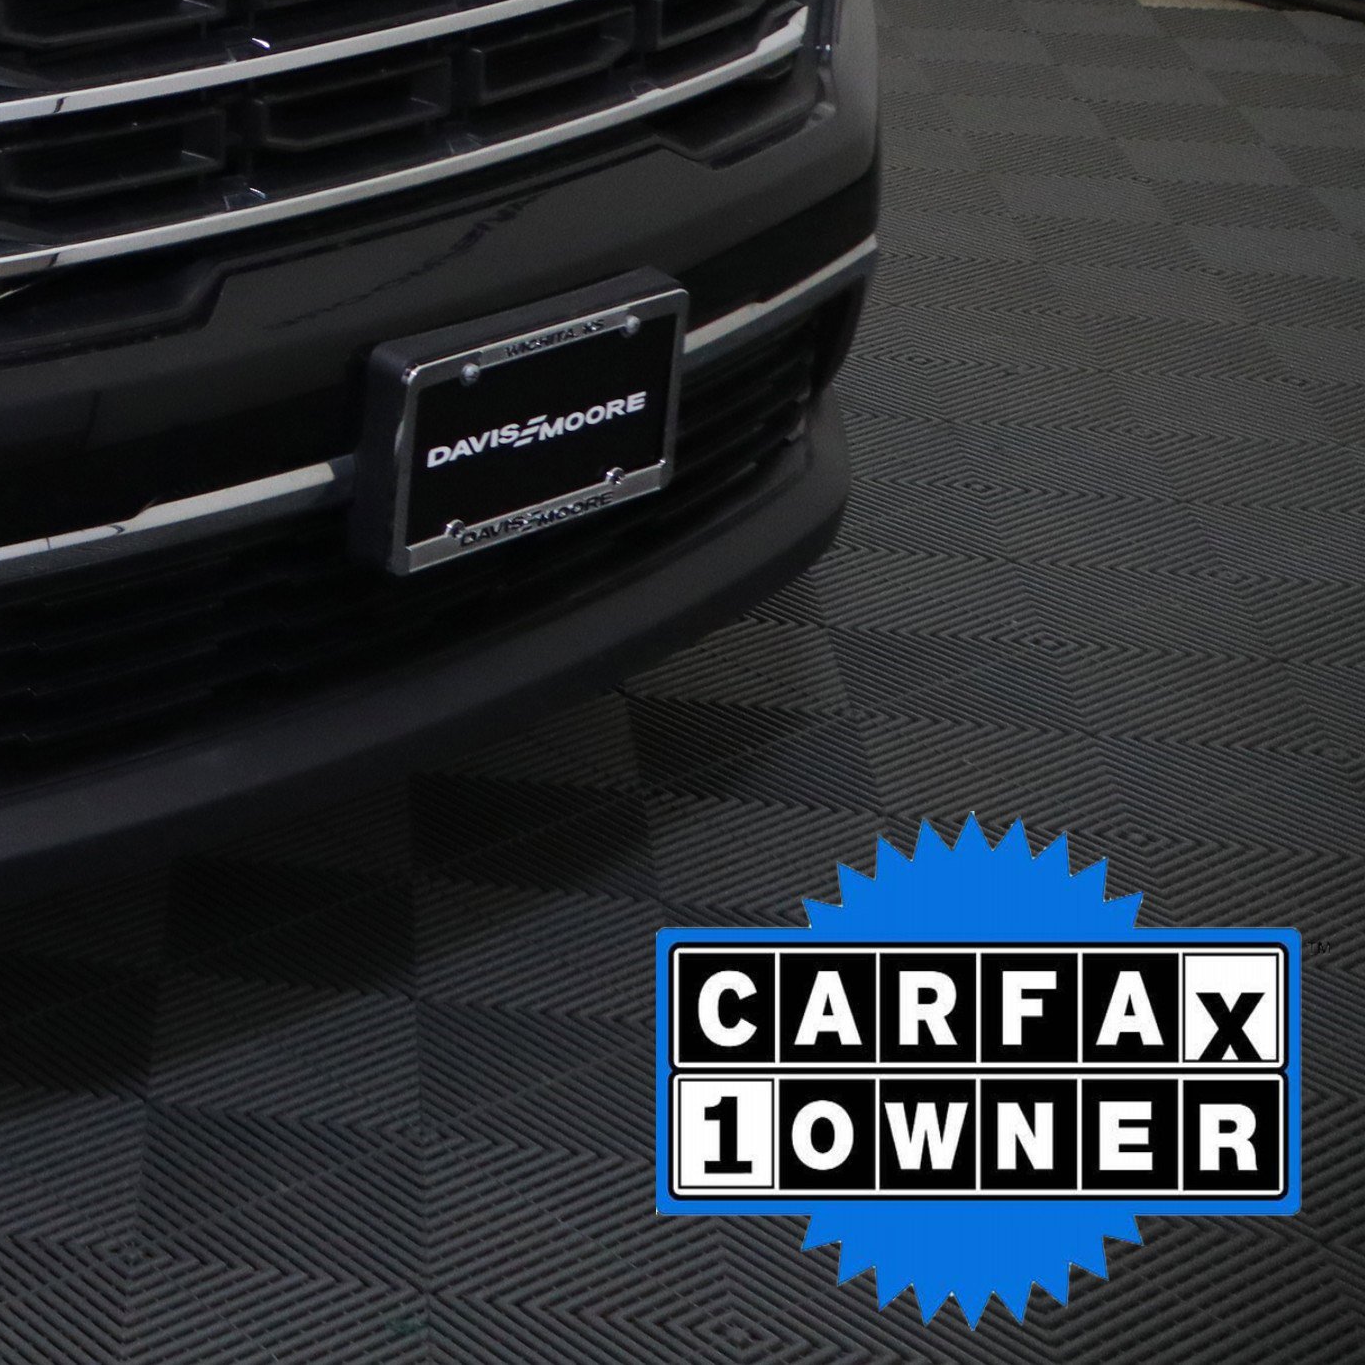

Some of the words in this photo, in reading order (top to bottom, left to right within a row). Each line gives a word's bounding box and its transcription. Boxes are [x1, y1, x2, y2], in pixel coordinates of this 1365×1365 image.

[427, 423, 521, 468] DAVIS
[539, 391, 647, 441] MOORE
[460, 515, 527, 547] DAVIS
[537, 491, 614, 526] MOORE
